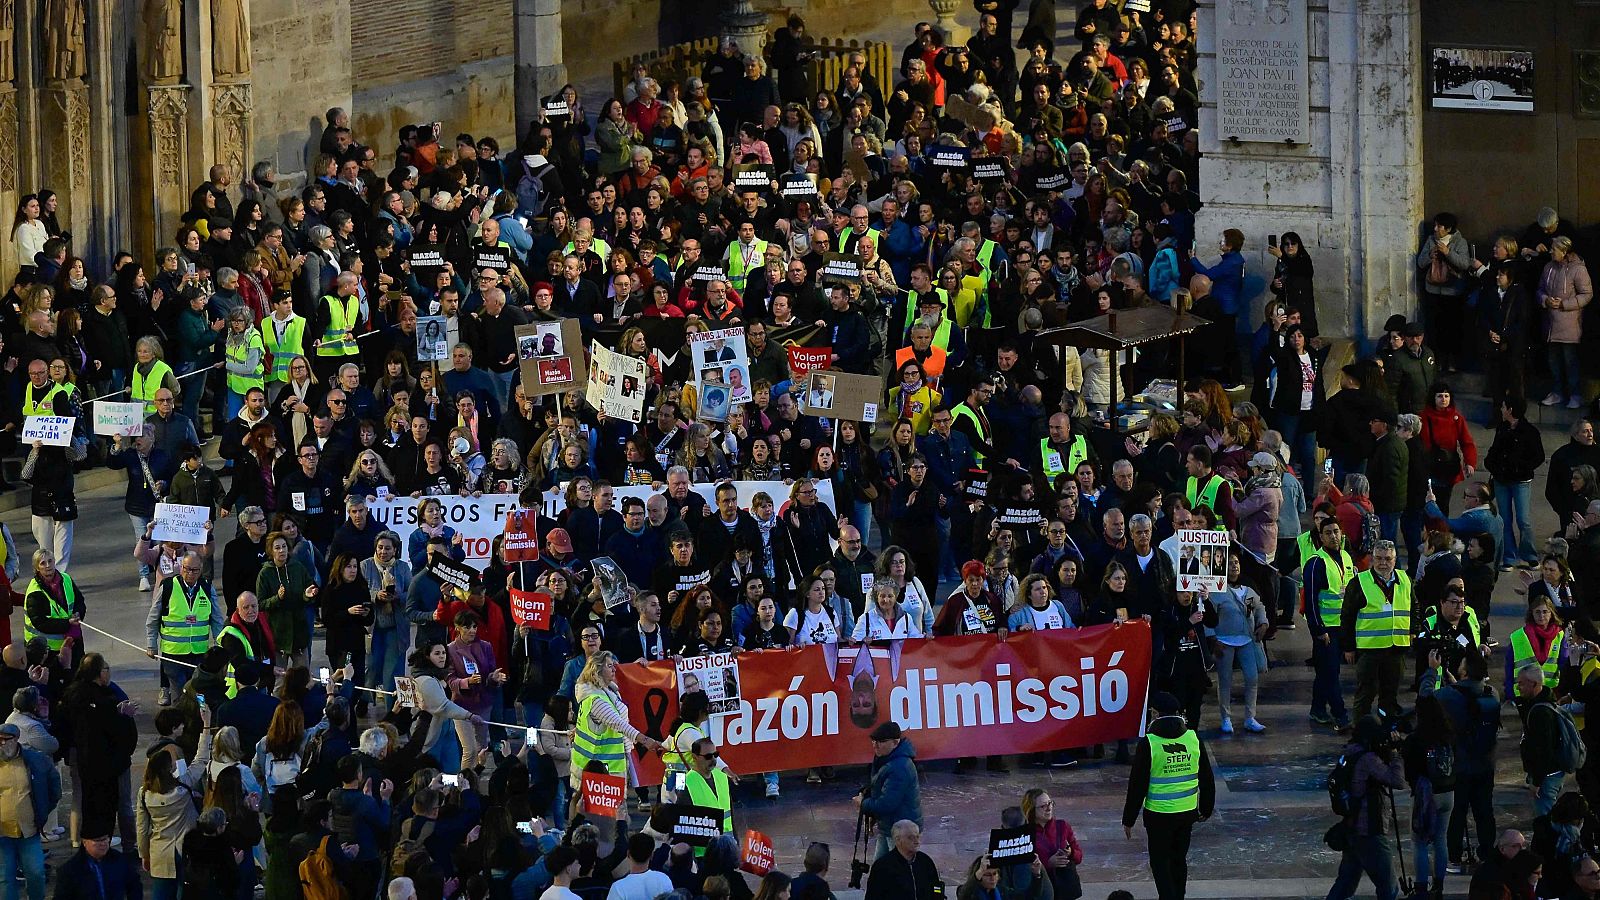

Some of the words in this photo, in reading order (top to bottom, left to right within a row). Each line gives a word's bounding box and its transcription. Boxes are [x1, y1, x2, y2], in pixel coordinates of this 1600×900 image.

[1273, 40, 1284, 48] DE
[1228, 67, 1259, 80] JOAN
[937, 151, 963, 160] MAZÓN
[933, 158, 966, 167] DIMISSIÓ
[738, 170, 767, 179] MAZÓN
[735, 177, 770, 186] DIMISSIÓ
[786, 180, 814, 188] MAZÓN
[783, 186, 817, 195] DIMISSIÓ
[412, 251, 440, 260] MAZÓN
[479, 253, 505, 261] MAZÓN
[476, 259, 508, 268] DIMISSIÓ
[829, 260, 857, 269] MAZÓN
[824, 266, 861, 277] DIMISSIÓ
[792, 350, 828, 363] Volem
[794, 359, 826, 371] votar.
[1005, 508, 1041, 517] MAZÓN
[1000, 515, 1043, 524] DIMISSIÓ
[505, 531, 530, 542] Mazón
[1180, 531, 1228, 544] JUSTICIA
[505, 539, 537, 551] dimissió
[437, 562, 471, 583] MAZÓN
[431, 566, 471, 592] DIMISSIÓ
[511, 593, 546, 611] Volem
[514, 607, 542, 622] votar.
[678, 655, 737, 672] JUSTICIA
[889, 650, 1130, 731] dimissió
[1166, 754, 1192, 764] STEPV
[585, 779, 621, 797] Volem
[588, 793, 618, 809] votar.
[679, 815, 717, 828] MAZÓN
[673, 824, 721, 838] DIMISSIÓ
[998, 834, 1032, 849] MAZÓN
[992, 843, 1034, 859] DIMISSIÓ
